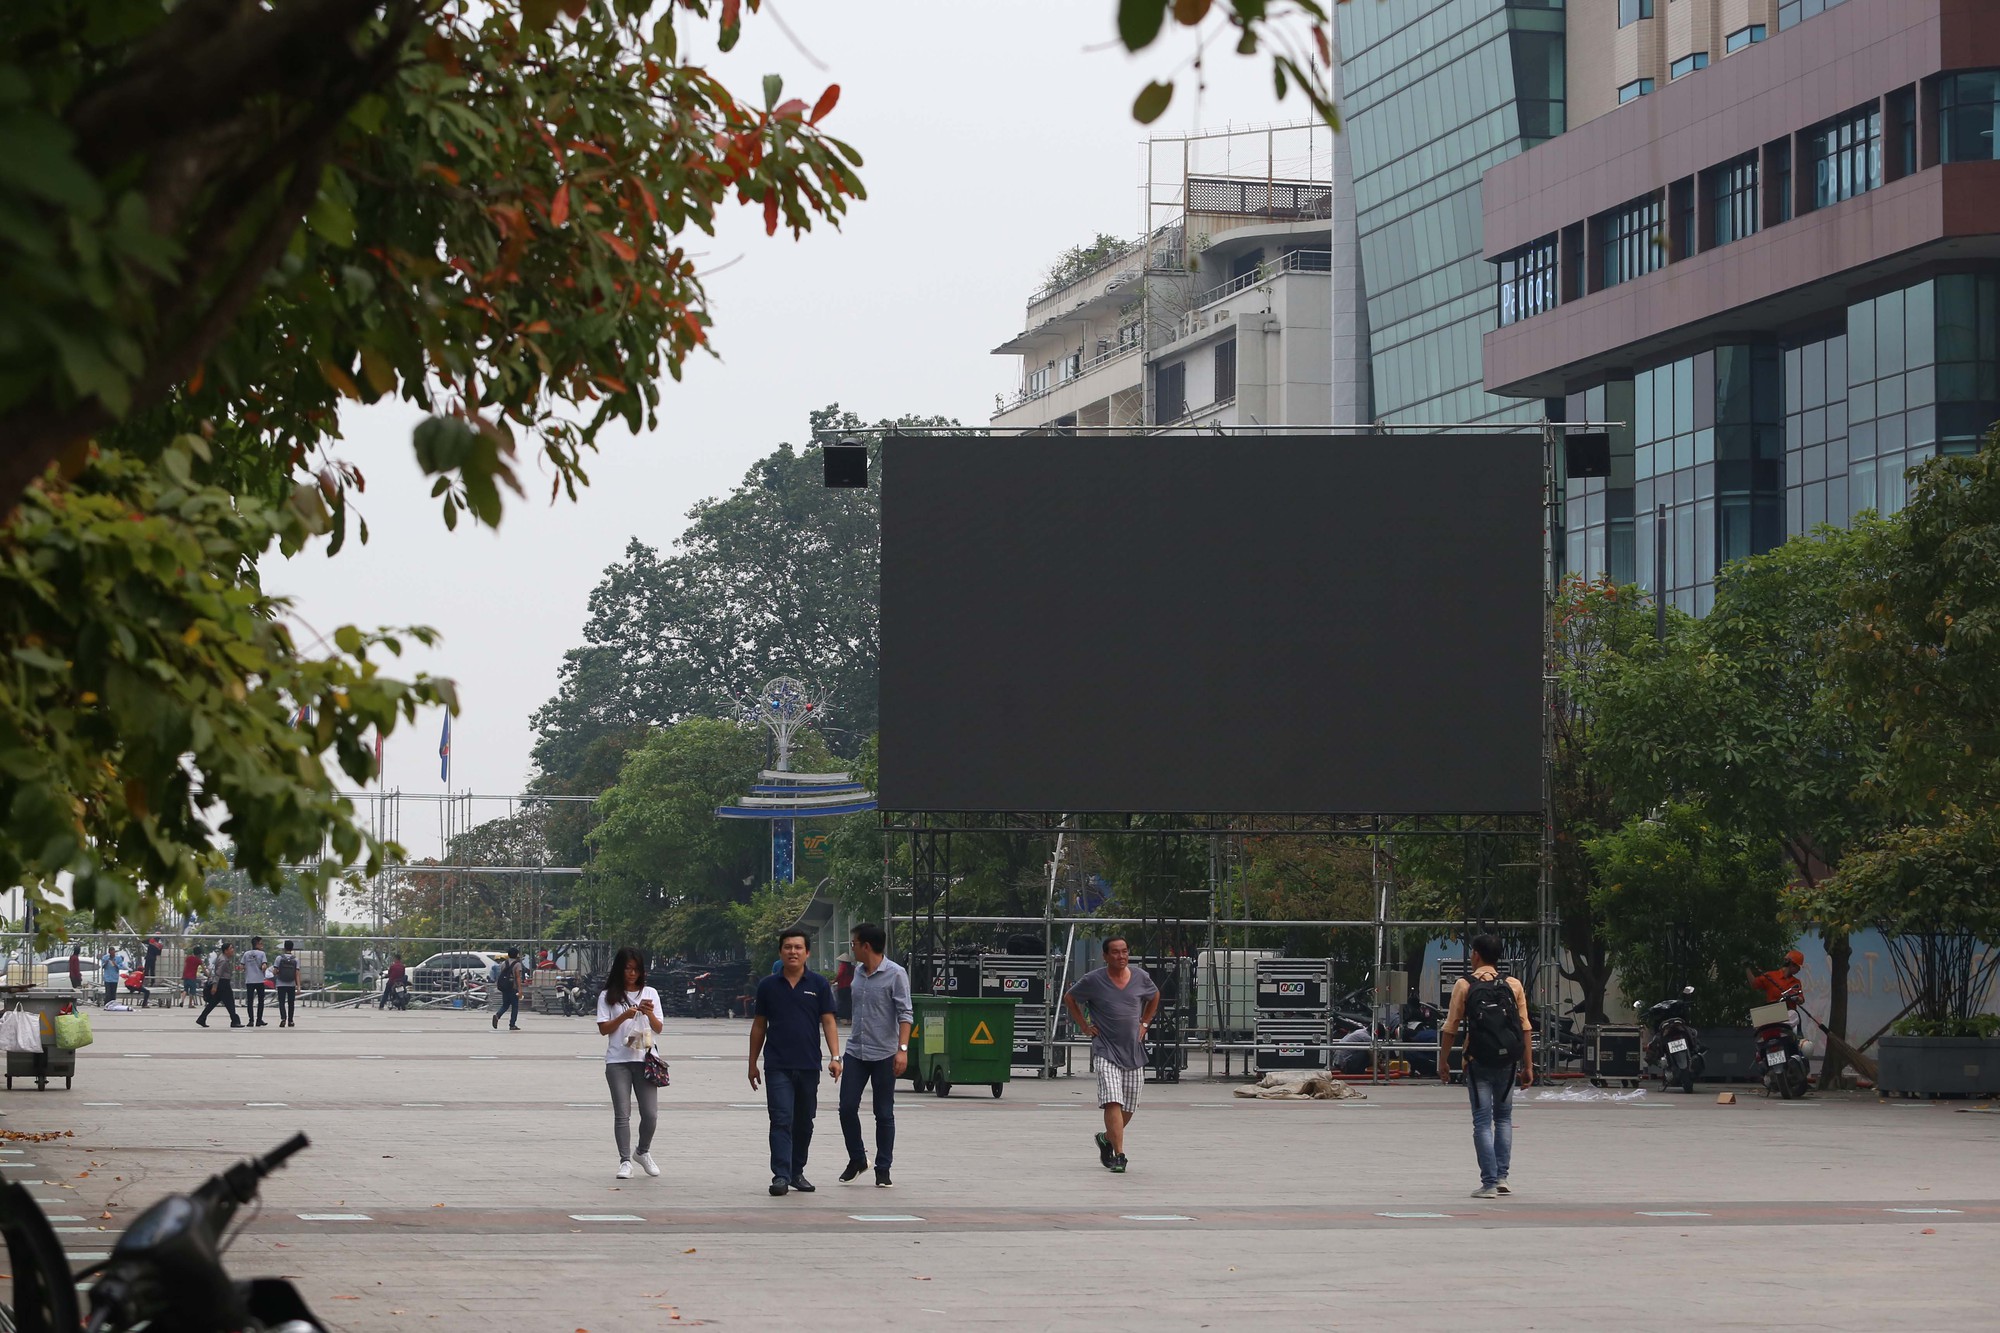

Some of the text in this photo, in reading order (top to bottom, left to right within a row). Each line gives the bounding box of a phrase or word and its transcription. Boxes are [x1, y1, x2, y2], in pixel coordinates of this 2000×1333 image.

[934, 978, 957, 987] HE
[1005, 979, 1028, 989] HNE
[1280, 983, 1304, 992] HNE
